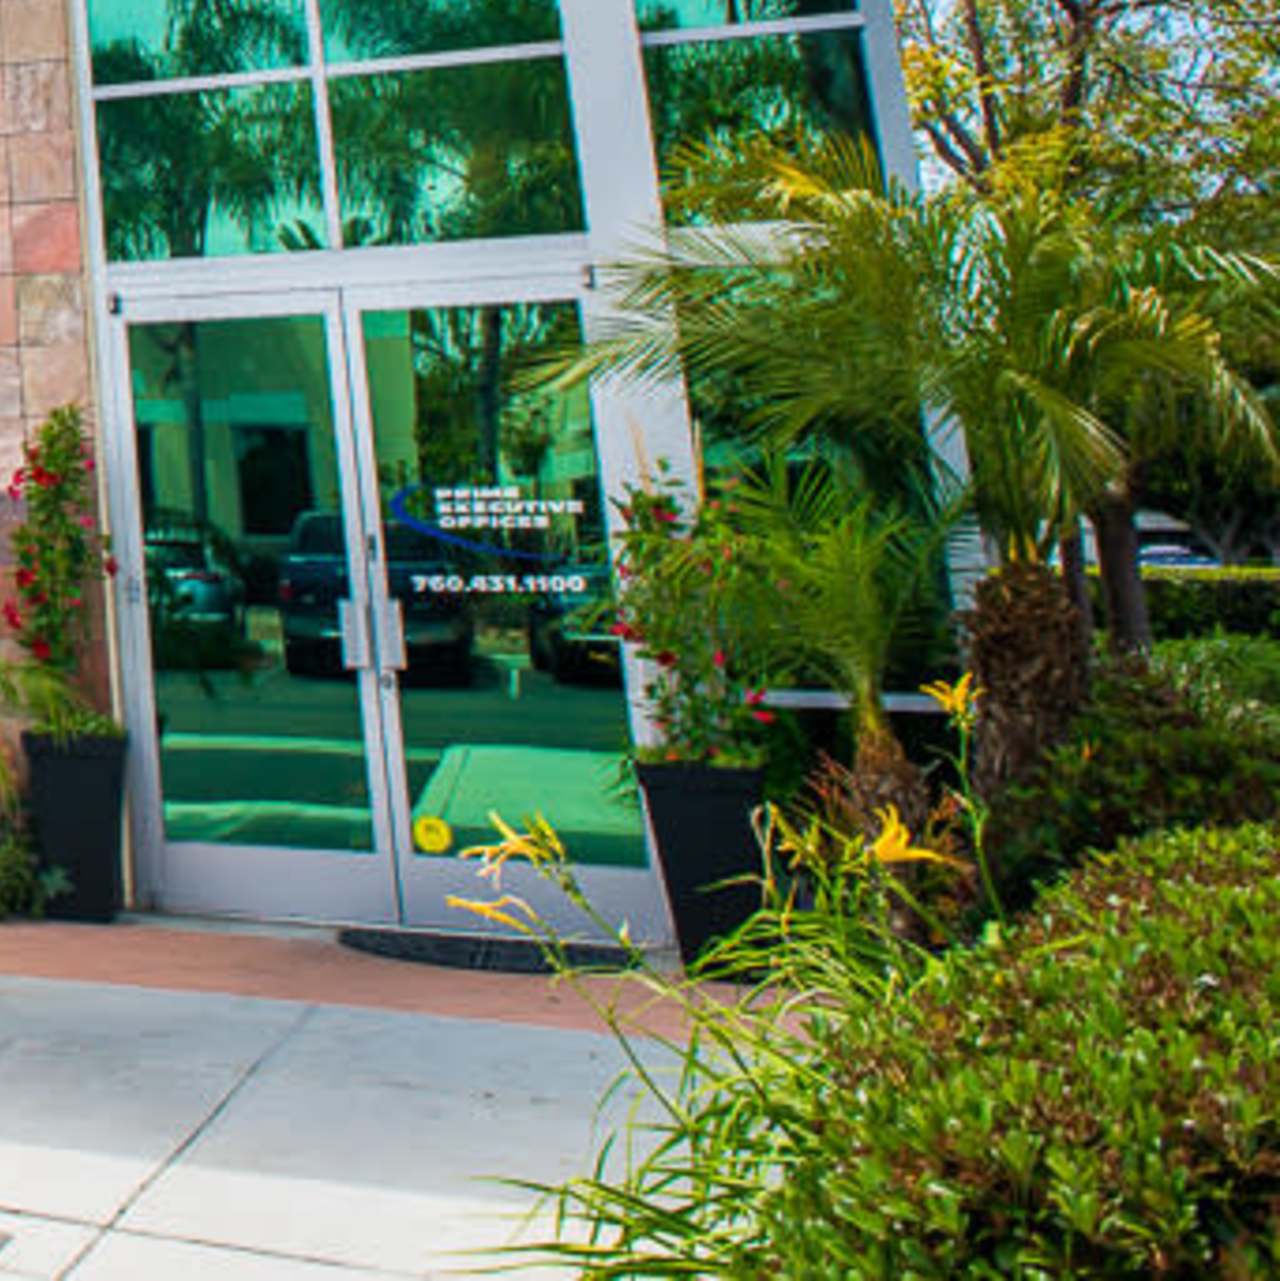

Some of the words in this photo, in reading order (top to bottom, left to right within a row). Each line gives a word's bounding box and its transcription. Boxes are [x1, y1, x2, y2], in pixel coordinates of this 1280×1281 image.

[435, 486, 520, 499] PRIME
[437, 500, 584, 514] EXECUTIVE
[411, 574, 587, 592] 760.431.1100
